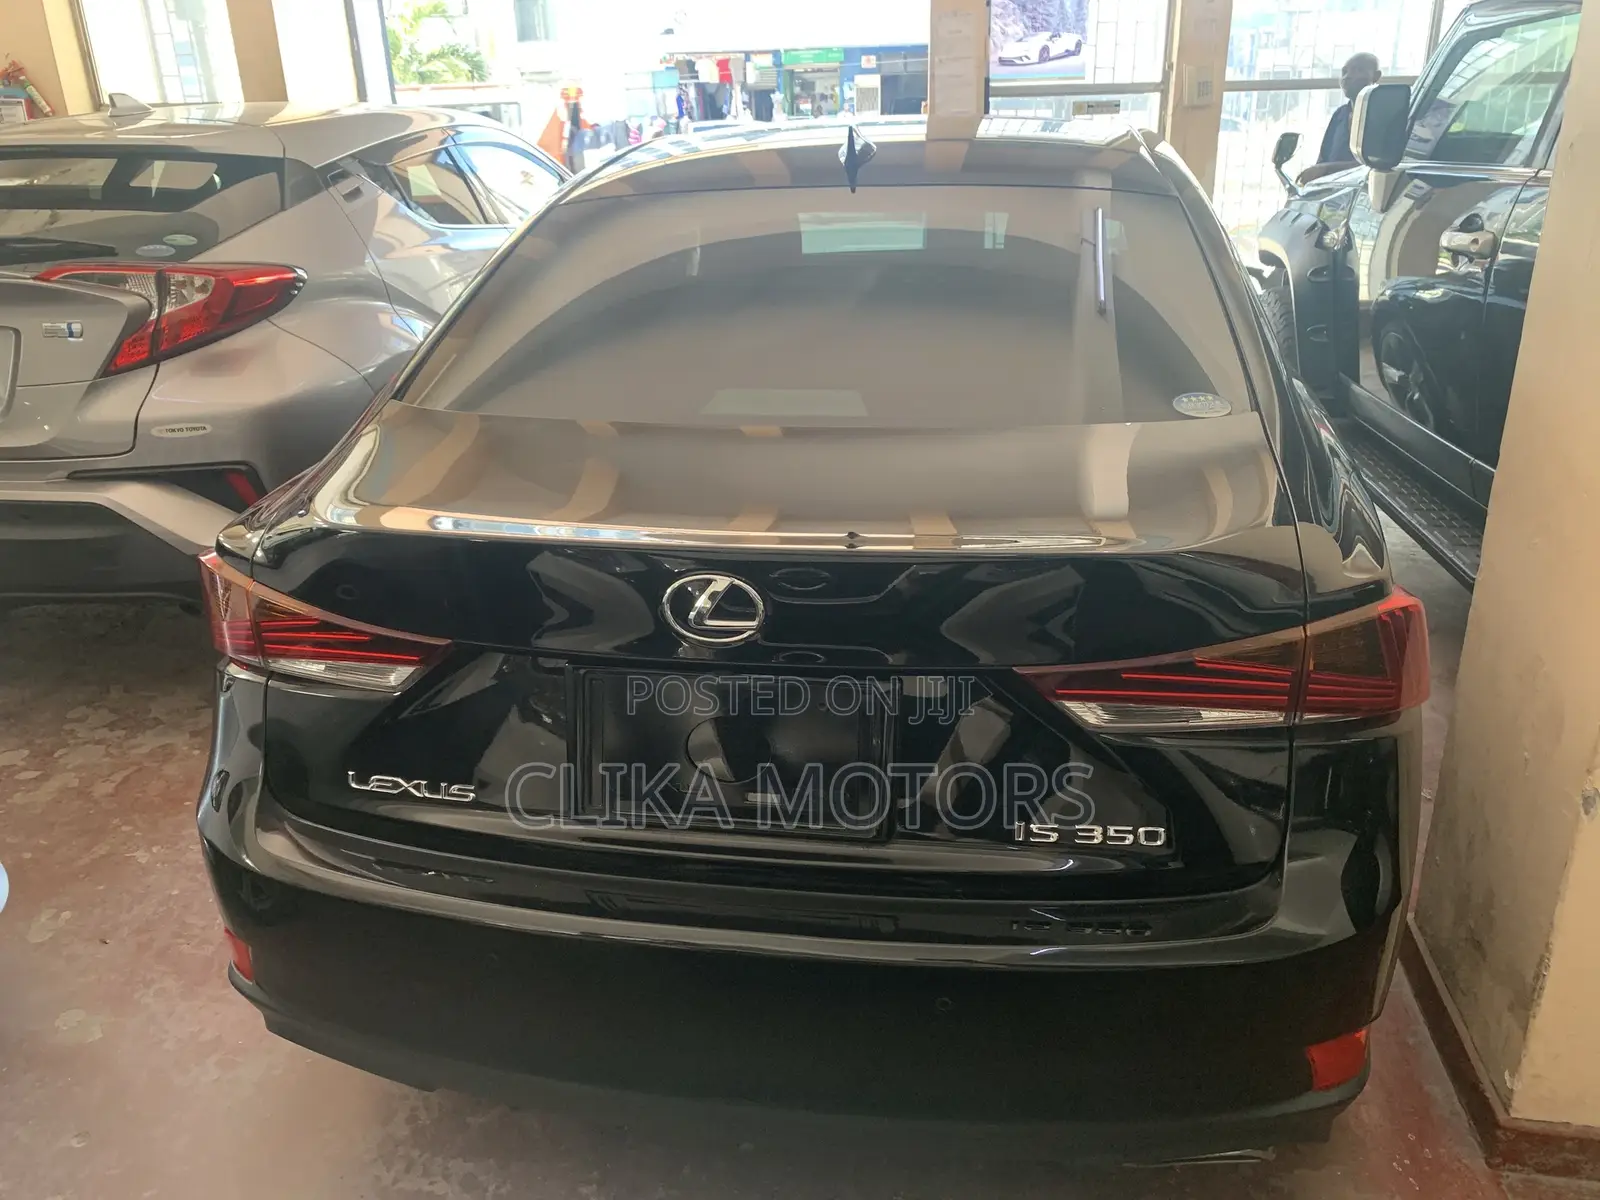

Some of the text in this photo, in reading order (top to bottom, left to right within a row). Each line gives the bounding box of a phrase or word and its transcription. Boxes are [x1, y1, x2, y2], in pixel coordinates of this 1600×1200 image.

[347, 770, 477, 802] LEXUS
[1014, 820, 1167, 847] IS 350
